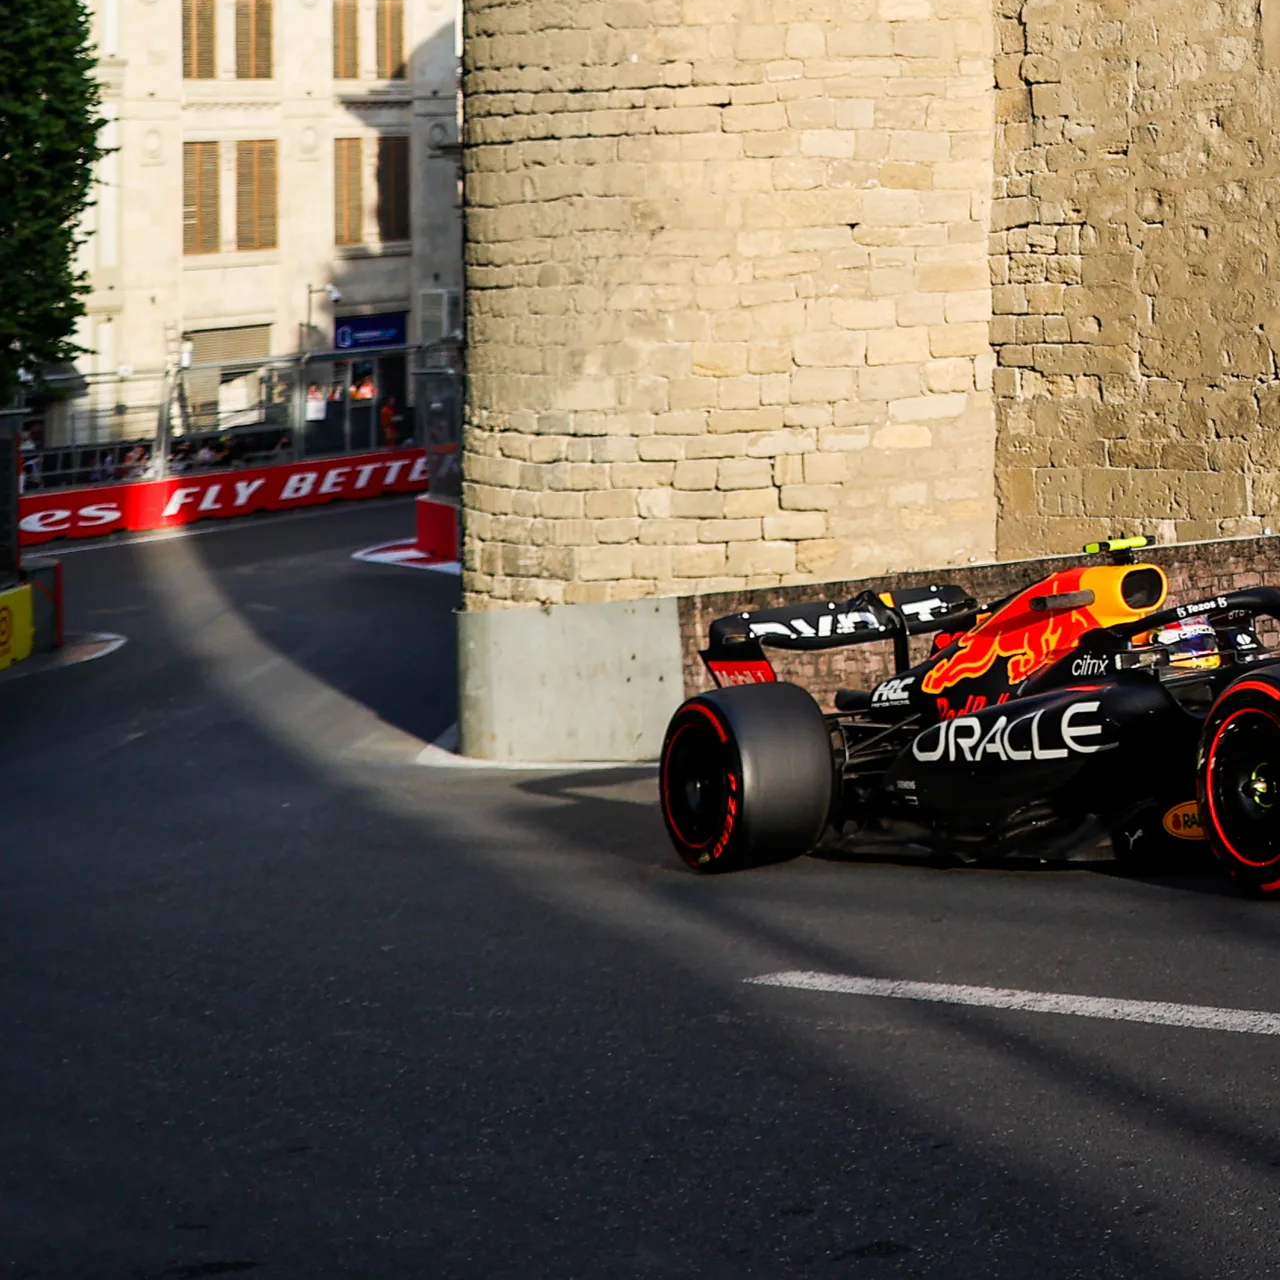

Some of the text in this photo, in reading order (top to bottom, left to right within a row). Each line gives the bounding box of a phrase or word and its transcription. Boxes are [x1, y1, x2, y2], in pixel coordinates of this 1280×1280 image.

[162, 478, 266, 517] FLY
[1186, 599, 1216, 615] Tezos
[912, 701, 1118, 762] ORACLE
